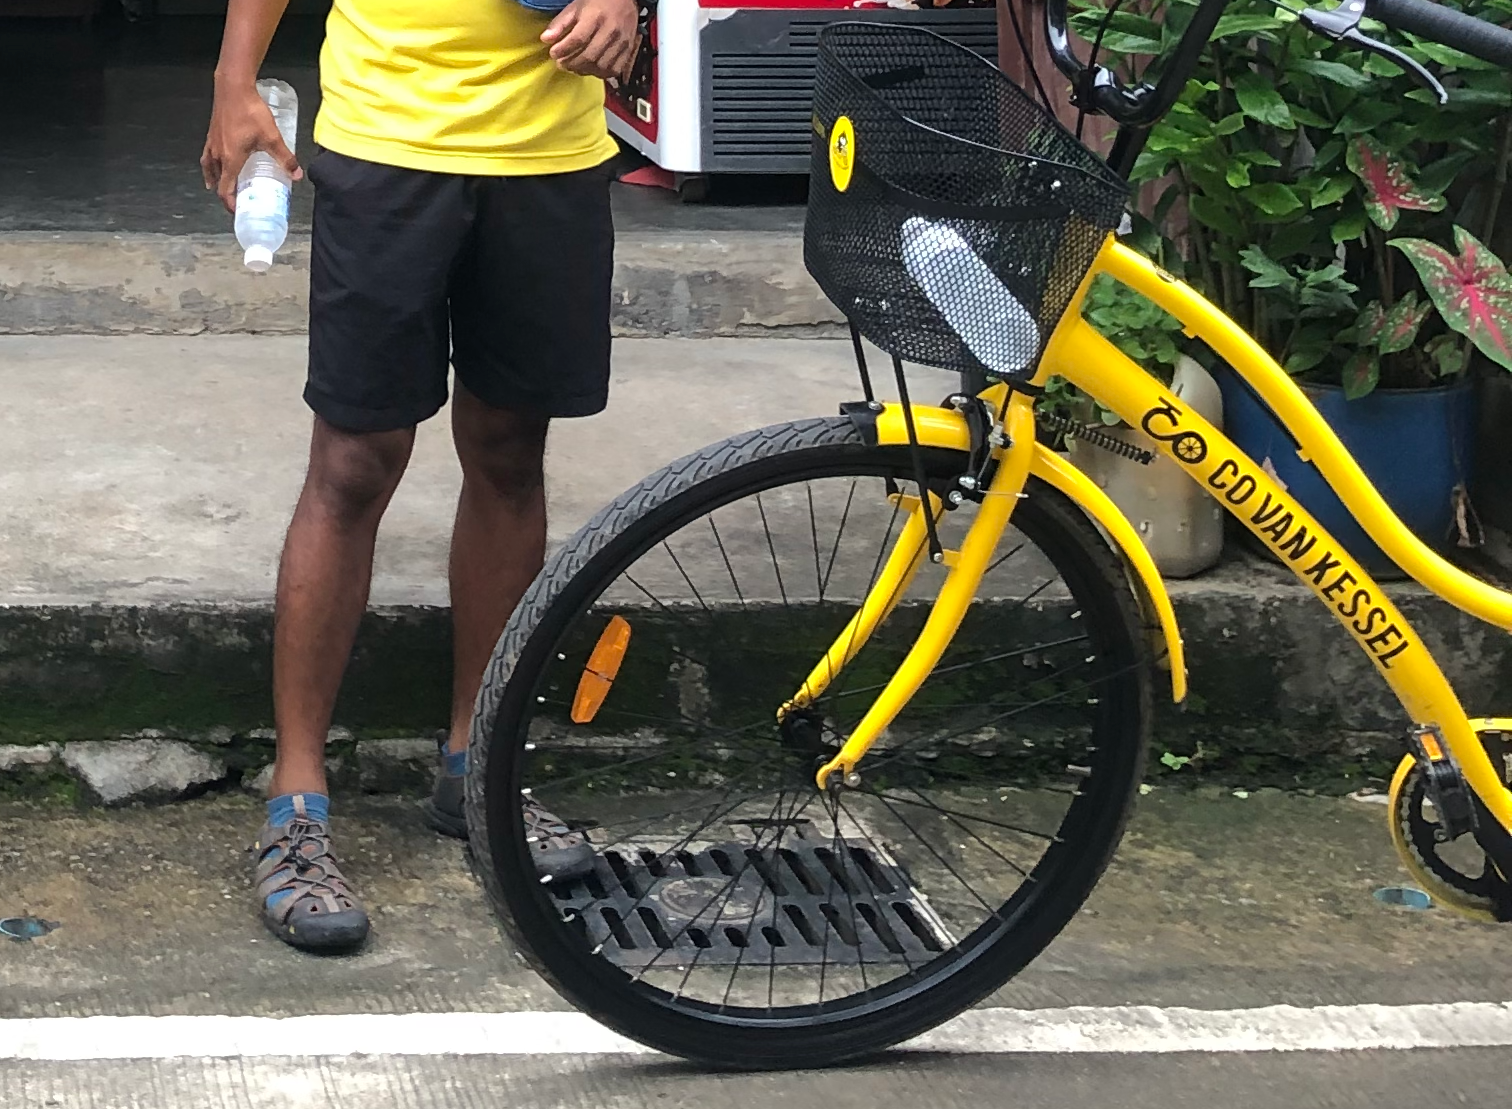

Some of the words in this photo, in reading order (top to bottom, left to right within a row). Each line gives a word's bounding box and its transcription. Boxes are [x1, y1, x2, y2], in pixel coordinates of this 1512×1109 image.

[1207, 458, 1257, 506] CO
[1250, 494, 1317, 561] VAN
[1304, 551, 1411, 670] KESSEL
